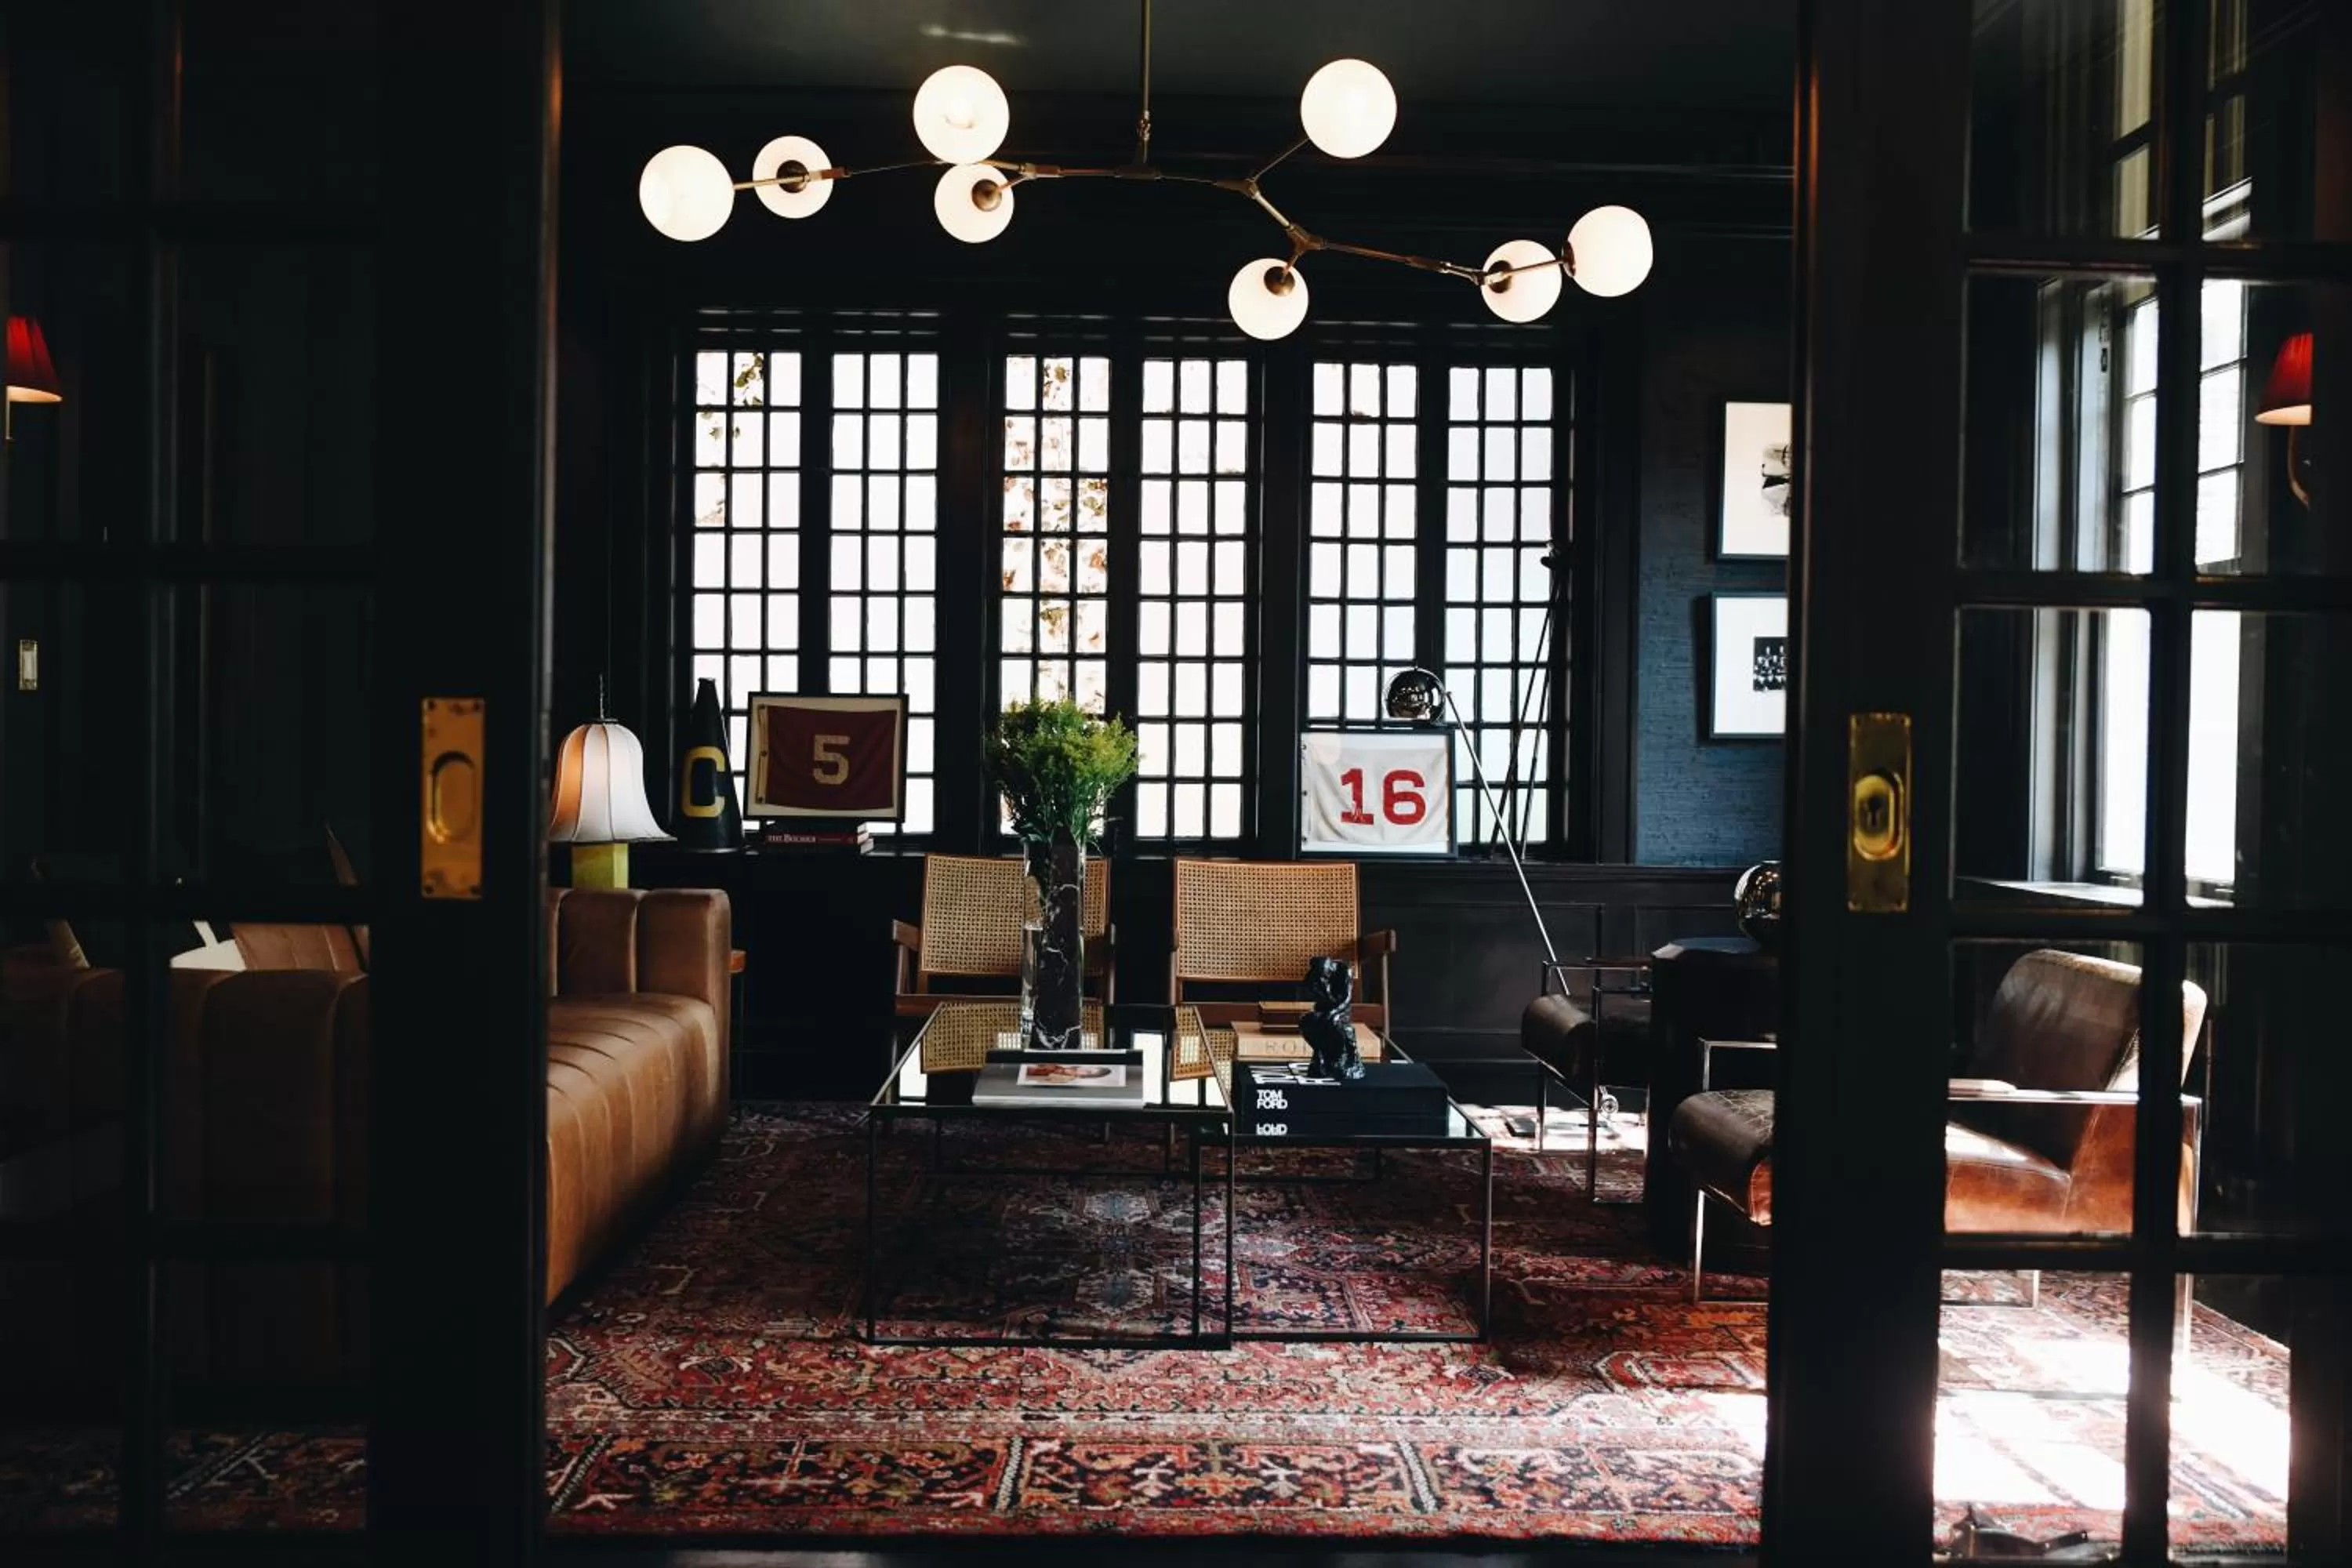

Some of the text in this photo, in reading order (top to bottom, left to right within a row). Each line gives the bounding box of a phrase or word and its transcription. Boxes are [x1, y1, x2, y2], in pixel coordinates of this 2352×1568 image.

[681, 746, 726, 818] C
[812, 734, 851, 786] 5
[1340, 768, 1426, 826] 16
[1256, 1089, 1283, 1099] TOM
[1256, 1098, 1288, 1109] FORD
